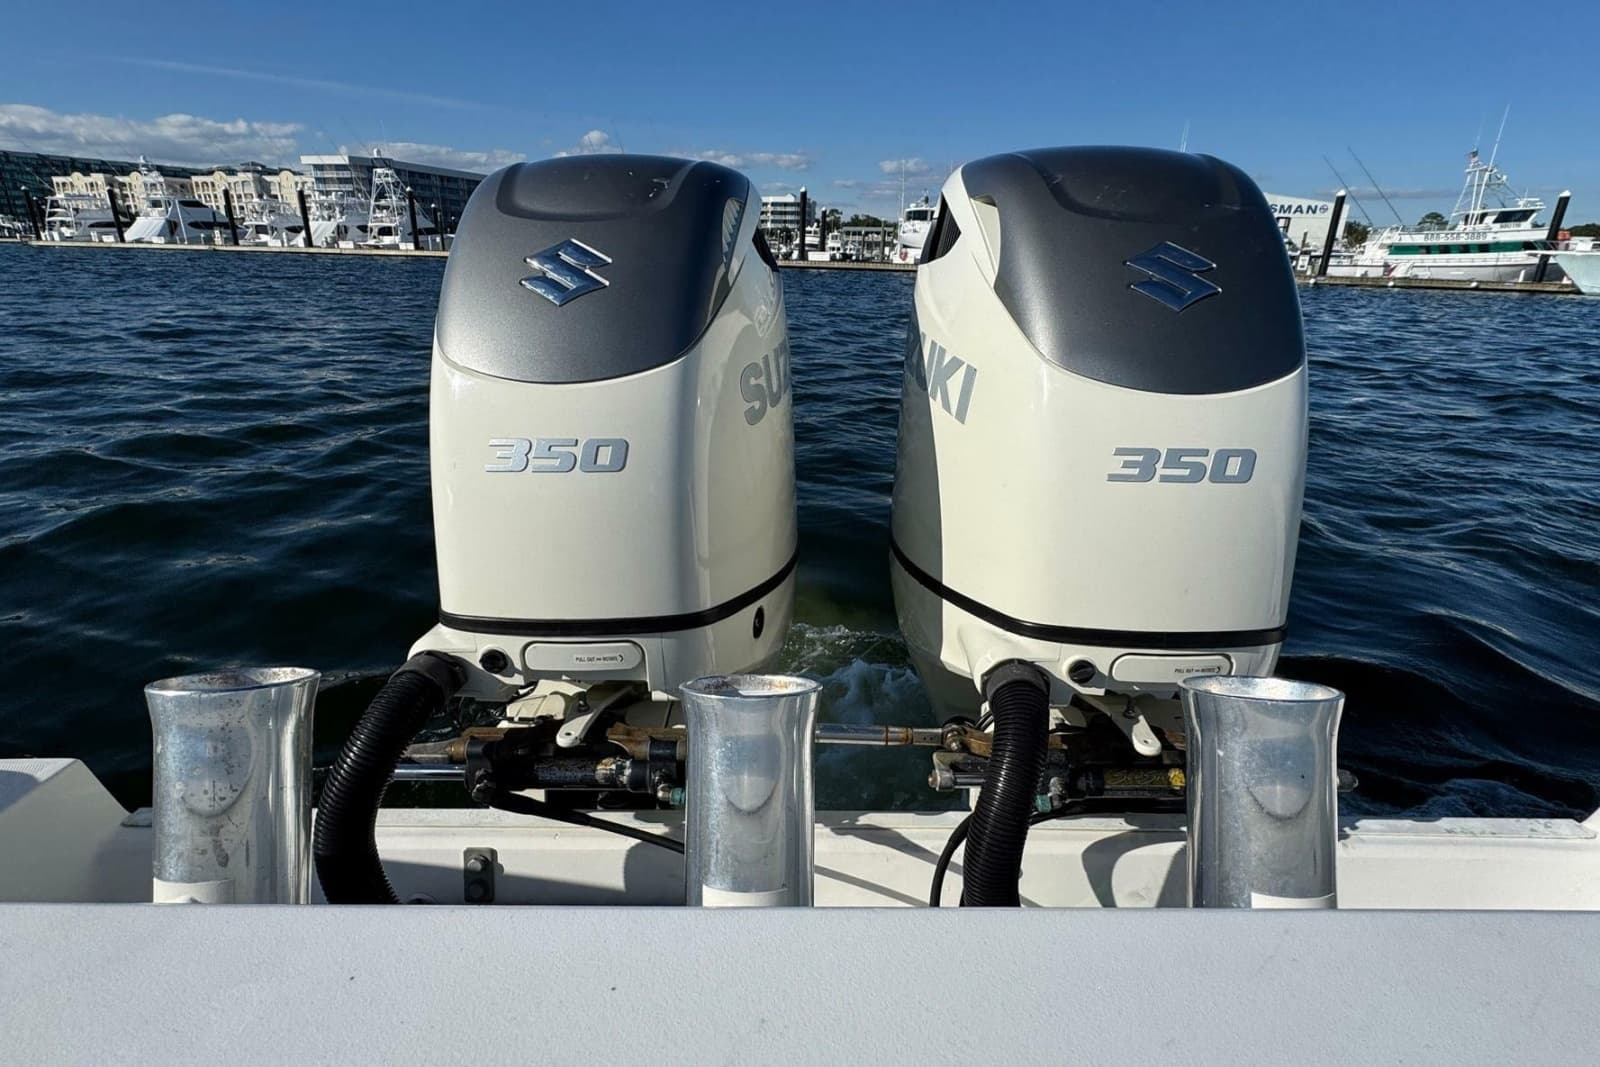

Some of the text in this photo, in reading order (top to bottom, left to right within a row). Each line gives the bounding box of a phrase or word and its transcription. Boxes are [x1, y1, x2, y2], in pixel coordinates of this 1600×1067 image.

[1270, 203, 1318, 215] SMAN
[484, 438, 630, 473] 350
[1106, 447, 1257, 483] 350
